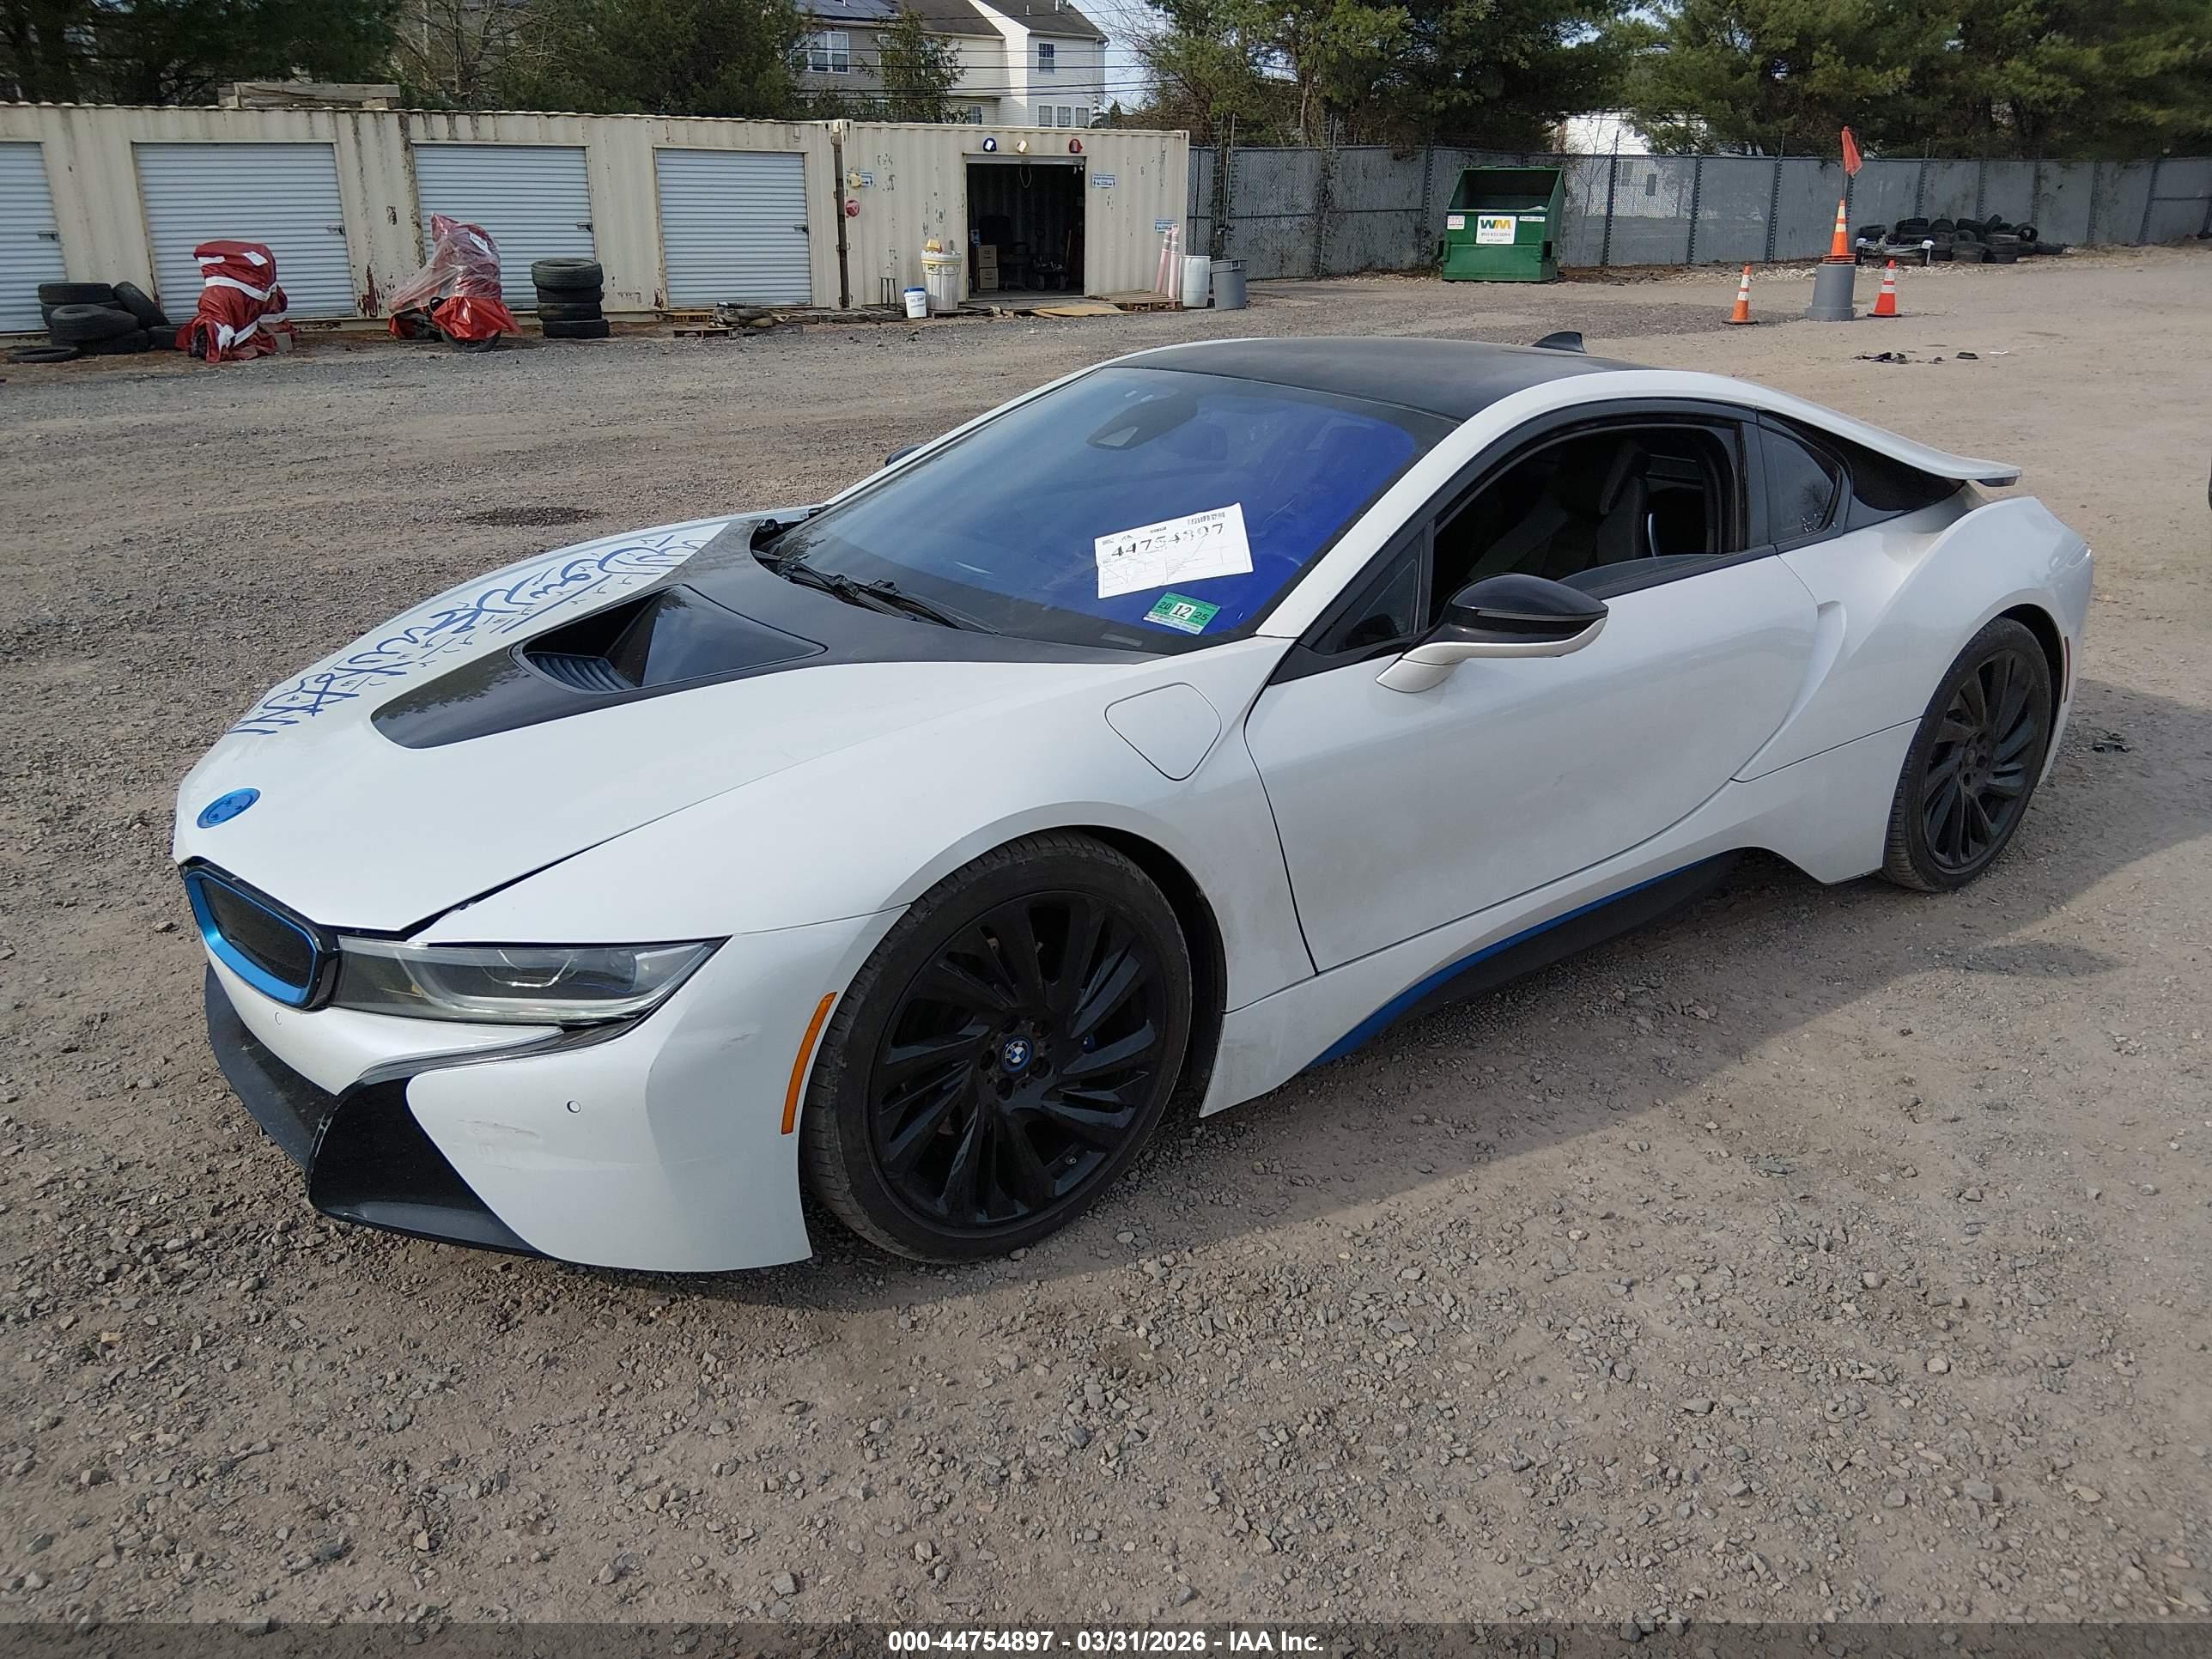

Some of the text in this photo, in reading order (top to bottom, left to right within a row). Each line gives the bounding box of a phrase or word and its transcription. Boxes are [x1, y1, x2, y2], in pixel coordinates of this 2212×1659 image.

[1480, 219, 1511, 229] WM
[1111, 522, 1224, 557] 44754897
[1171, 605, 1193, 618] 12
[1193, 611, 1210, 621] 25
